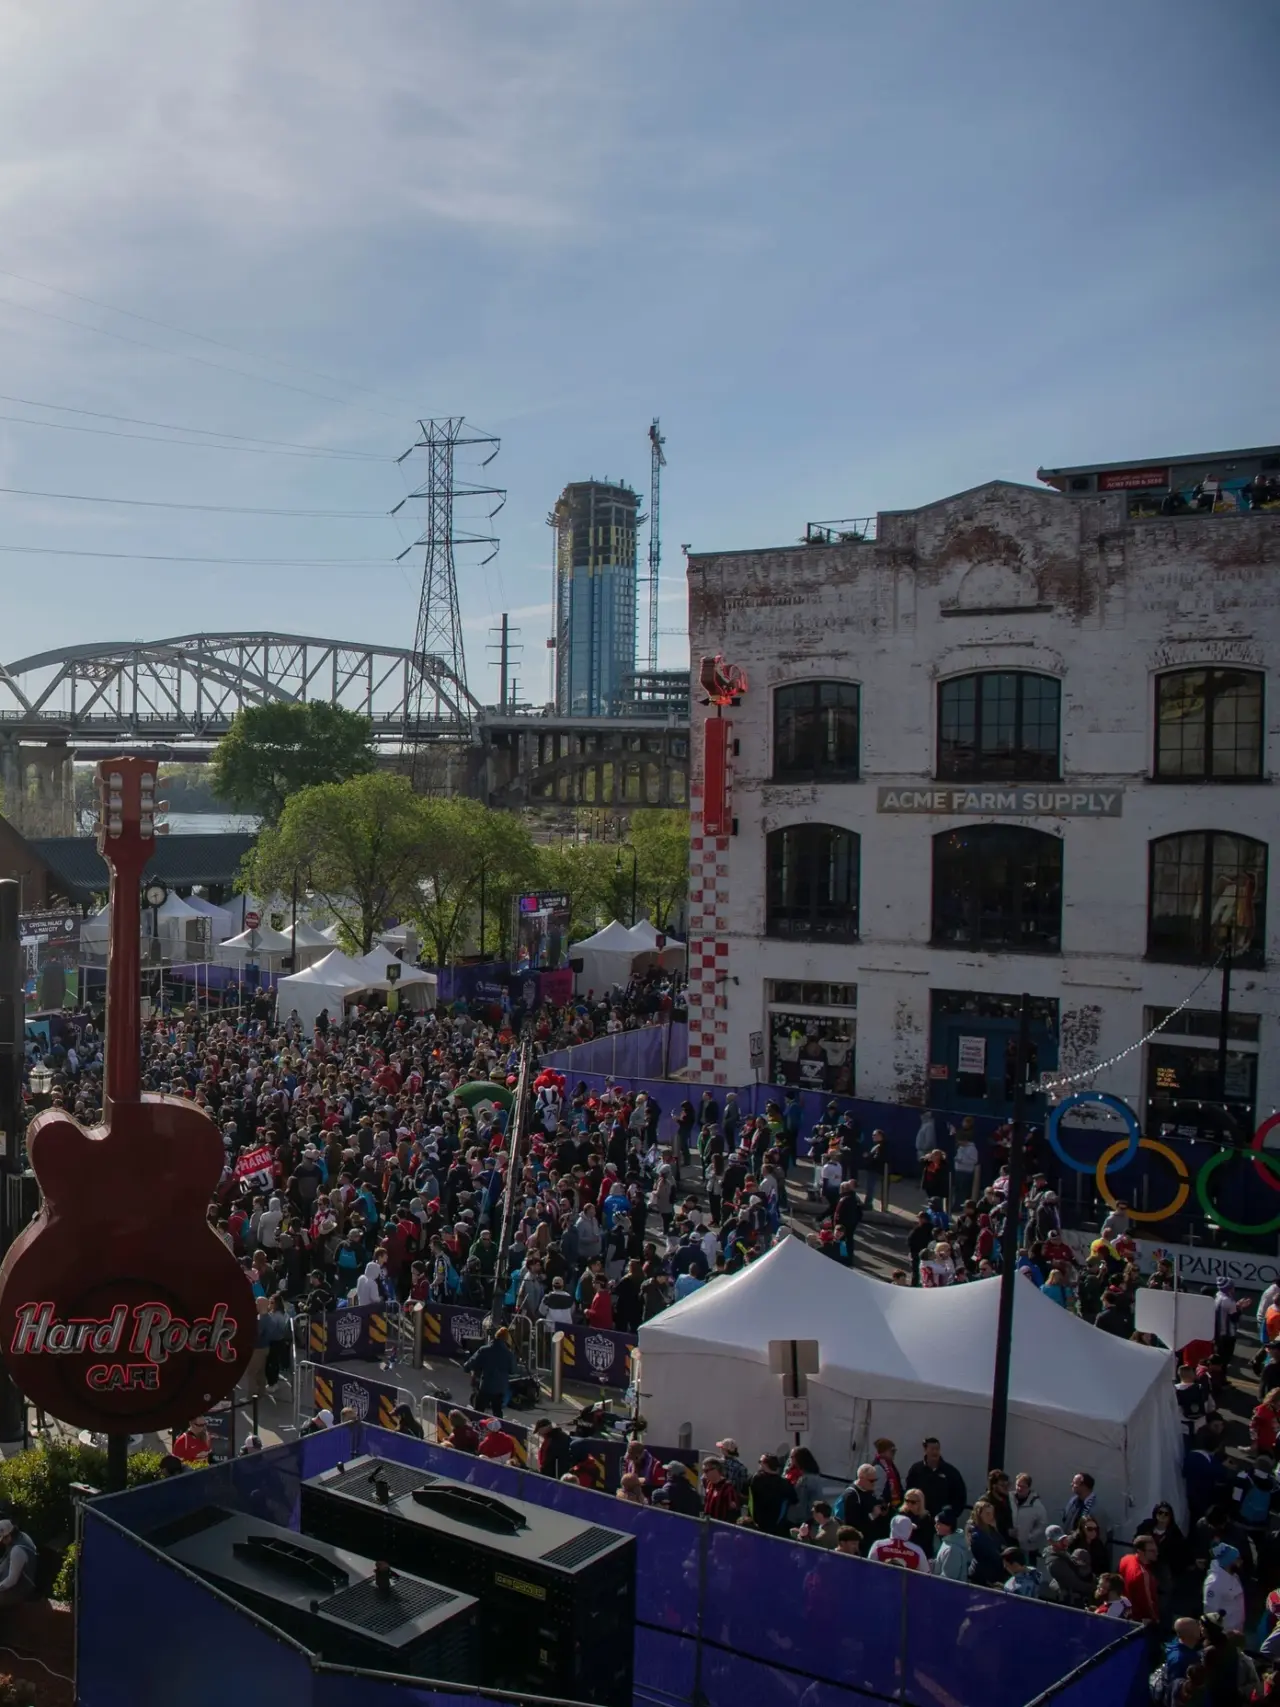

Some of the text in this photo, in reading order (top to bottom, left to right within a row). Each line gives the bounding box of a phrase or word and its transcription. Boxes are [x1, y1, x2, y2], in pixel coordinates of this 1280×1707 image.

[883, 792, 1116, 812] ACME FARM SUPPLY
[29, 921, 47, 929] CRYSTAL
[10, 1302, 238, 1363] Hard Rock
[86, 1364, 160, 1391] CAFE
